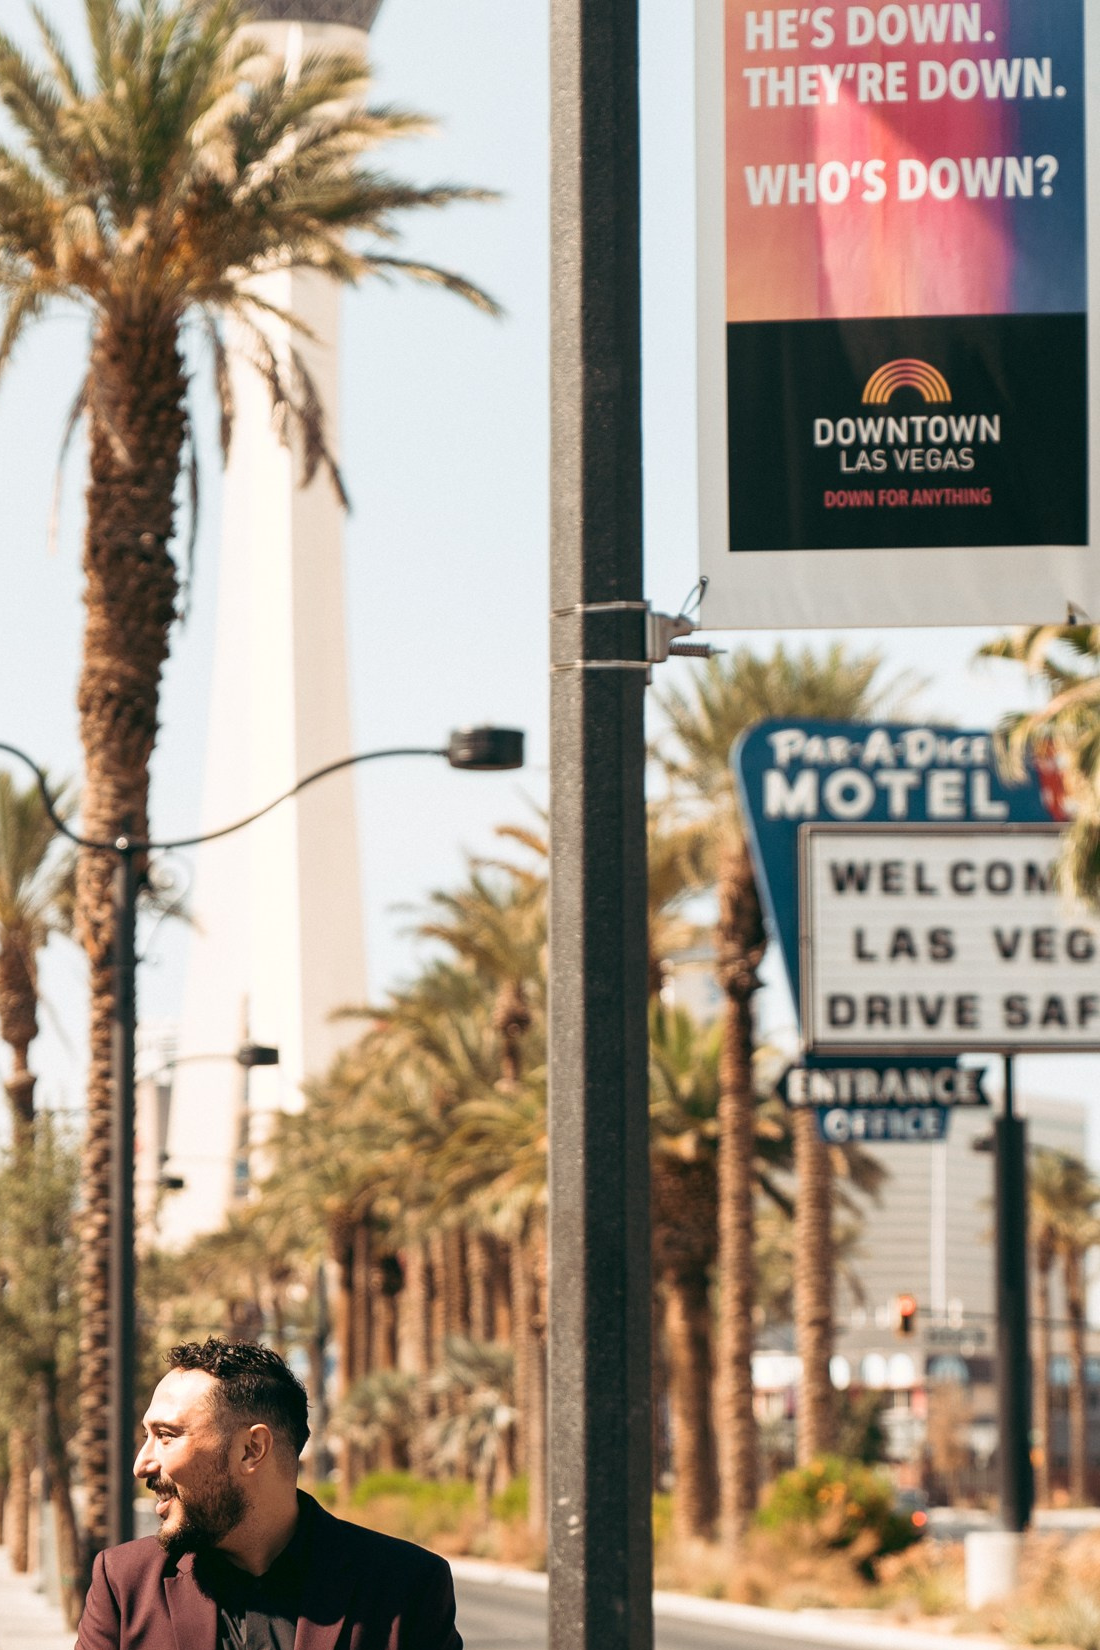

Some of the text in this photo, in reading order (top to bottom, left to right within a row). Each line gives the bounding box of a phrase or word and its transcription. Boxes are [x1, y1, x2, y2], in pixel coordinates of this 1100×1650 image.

[744, 2, 996, 52] HE'S DOWN.
[742, 56, 1067, 107] THEY'RE DOWN.
[744, 154, 1059, 206] WHO'S DOWN?
[814, 414, 1002, 448] DOWNTOWN
[840, 447, 976, 474] LAS VEGAS
[823, 486, 993, 509] DOWN FOR ANYTHING
[762, 767, 1010, 820] MOTEL
[854, 926, 957, 963] LAS
[827, 993, 980, 1029] DRIVE
[786, 1067, 981, 1106] ENTRANCE
[822, 1107, 941, 1142] OFFICE
